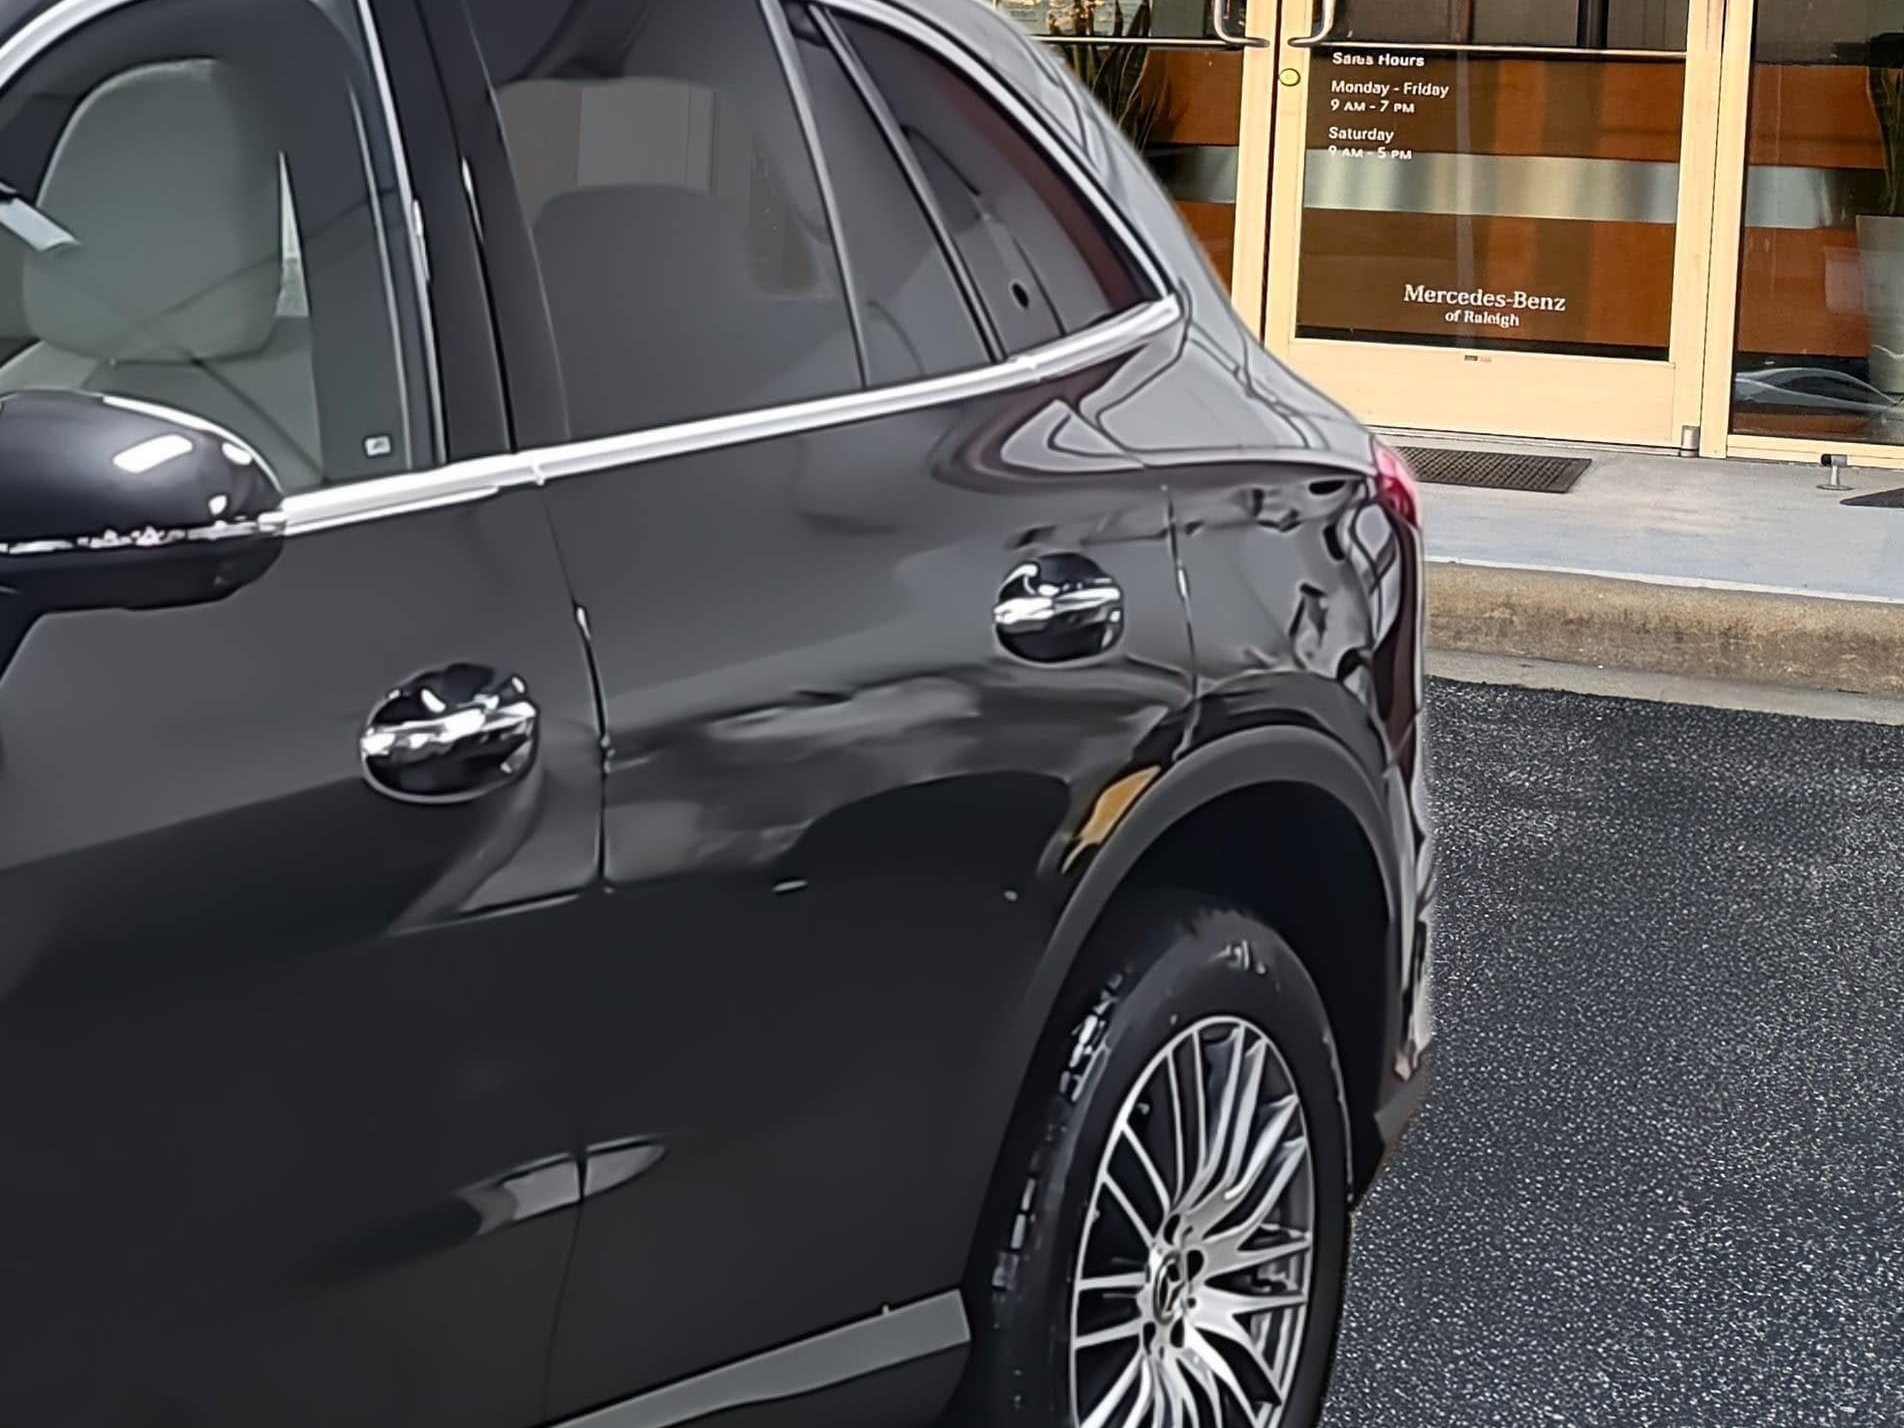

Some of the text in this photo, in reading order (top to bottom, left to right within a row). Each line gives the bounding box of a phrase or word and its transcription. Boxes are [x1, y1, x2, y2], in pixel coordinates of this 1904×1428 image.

[1378, 53, 1425, 67] Hours
[1331, 80, 1390, 97] Monday
[1403, 82, 1449, 98] Friday
[1330, 98, 1340, 111] 9
[1344, 102, 1366, 112] AM
[1380, 100, 1389, 112] 7
[1393, 103, 1415, 113] PM
[1328, 126, 1394, 144] Saturday
[1328, 145, 1337, 157] 9
[1342, 148, 1364, 158] AM
[1377, 146, 1387, 158] 5
[1391, 150, 1412, 159] PM
[1403, 283, 1566, 311] Mercedes-Benz
[1445, 310, 1520, 328] of Raleigh
